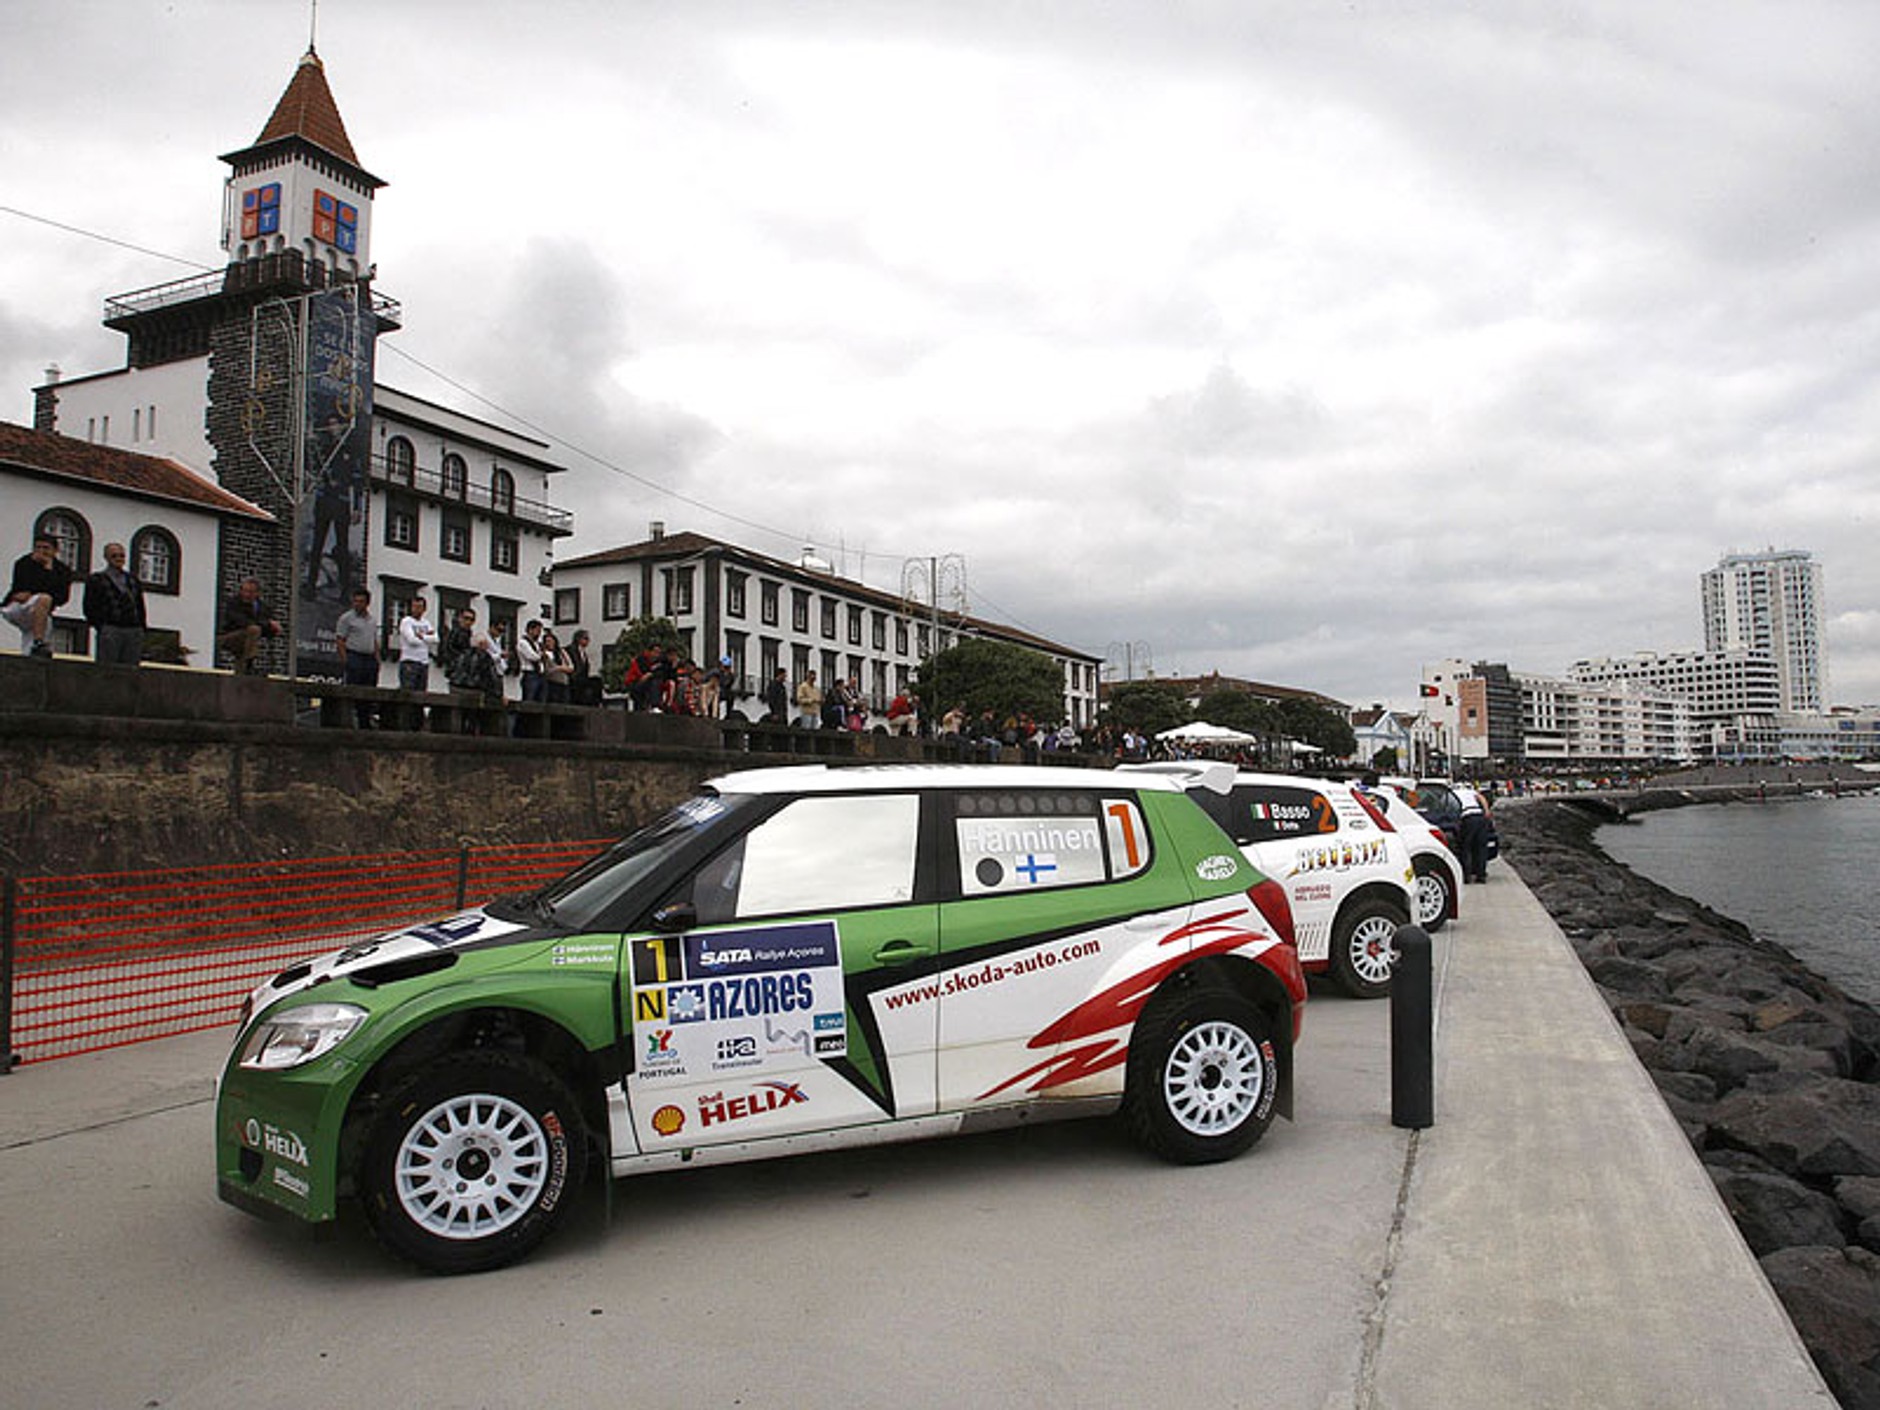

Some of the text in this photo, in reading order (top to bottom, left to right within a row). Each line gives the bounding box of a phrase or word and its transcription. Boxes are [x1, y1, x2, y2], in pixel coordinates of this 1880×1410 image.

[1270, 803, 1311, 819] Basso
[1311, 794, 1337, 833] 2
[1108, 803, 1140, 868] 1
[646, 939, 668, 982] 1
[700, 948, 753, 966] SATA
[884, 939, 1101, 1010] www.skoda-auto.com
[637, 991, 663, 1020] N
[700, 1082, 810, 1127] HELIX
[264, 1129, 309, 1167] HELIX
